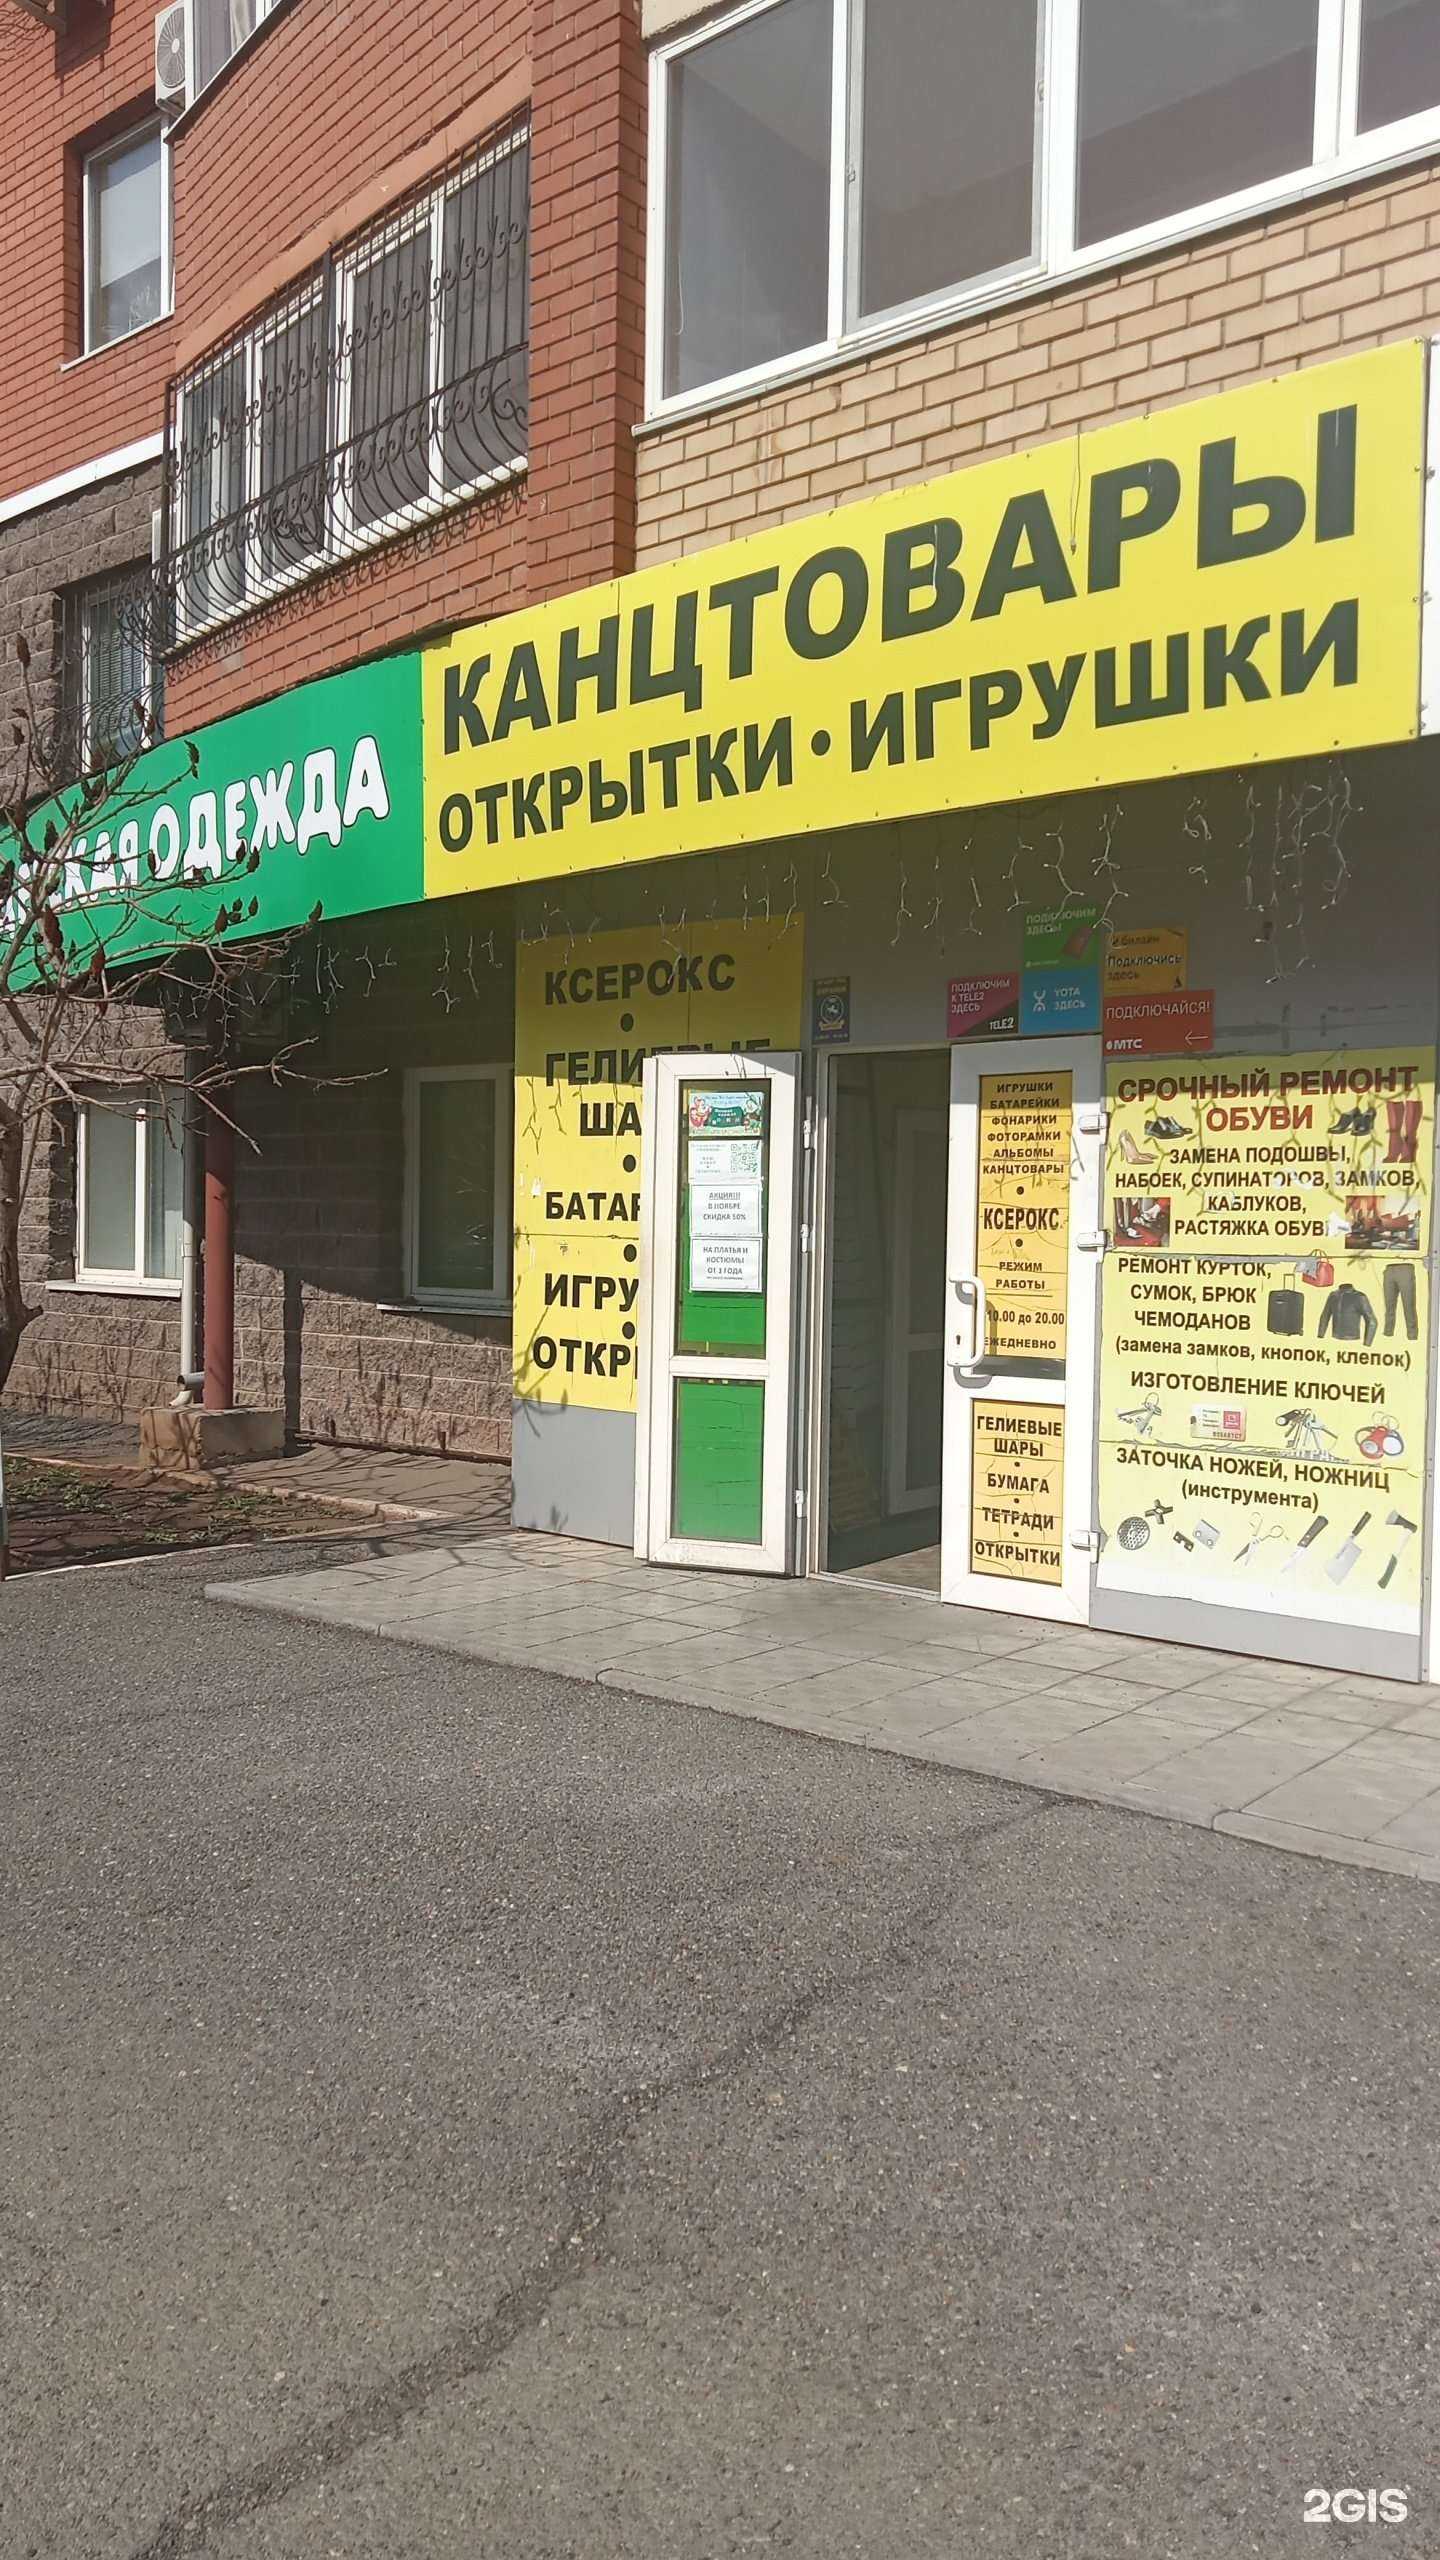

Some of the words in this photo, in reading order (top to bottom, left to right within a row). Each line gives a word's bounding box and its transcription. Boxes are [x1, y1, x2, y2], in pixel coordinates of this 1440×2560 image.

[441, 403, 1359, 755] КАНЦТОВАРЫ
[437, 714, 793, 853] ОТКРЫТКИ
[849, 598, 1359, 773] ИГРУШКИ
[149, 735, 391, 881] ОДЕЖДА
[544, 954, 736, 1005] КСЕРОКС
[952, 979, 1010, 992] ПОДКЛЮЧИМ
[960, 992, 984, 1002] TELE2
[1054, 987, 1080, 996] YOTA
[952, 1003, 980, 1014] ЗДЕСЬ
[1055, 1000, 1085, 1010] ЗДЕСЬ
[1106, 1000, 1209, 1019] ПОДКЛЮЧАЙСЯ!
[990, 1017, 1014, 1030] TELE2
[1114, 1039, 1142, 1049] МТС
[997, 1082, 1053, 1093] ИГРУШКИ
[1118, 1068, 1270, 1103] СРОЧНЫЙ
[1279, 1066, 1419, 1096] РЕМОНТ
[990, 1097, 1060, 1109] БАТАРЕЙКИ
[992, 1115, 1057, 1126] ФОНАРИКИ
[1206, 1105, 1314, 1131] ОБУВИ
[987, 1131, 1061, 1142] ФОТОРАМКИ
[993, 1148, 1054, 1158] АЛЬБОМЫ
[1170, 1147, 1240, 1164] ЗАМЕНА
[1246, 1146, 1350, 1164] ПОДОШВЫ,
[983, 1164, 1064, 1175] КАНЦТОВАРЫ
[1115, 1172, 1187, 1190] НАБОЕК,
[1335, 1170, 1420, 1188] ЗАМКОВ,
[1208, 1195, 1307, 1213] КАБЛУКОВ,
[984, 1208, 1059, 1230] КСЕРОКС
[1175, 1220, 1269, 1236] РАСТЯЖКА
[999, 1261, 1042, 1272] РЕЖИМ
[1118, 1258, 1190, 1274] РЕМОНТ
[1197, 1260, 1272, 1279] КУРТОК,
[996, 1279, 1045, 1289] РАБОТЫ
[1130, 1284, 1197, 1303] СУМОК,
[1202, 1286, 1257, 1303] БРЮК
[988, 1310, 1015, 1322] 10.00
[1018, 1314, 1031, 1325] до
[1035, 1312, 1064, 1324] 20.00
[1134, 1310, 1251, 1331] ЧЕМОДАНОВ
[984, 1337, 1056, 1349] ЕЖЕДНЕВНО
[533, 1336, 638, 1379] ОТКР
[1116, 1336, 1182, 1354] (замена
[1187, 1342, 1256, 1361] замков,
[1261, 1346, 1331, 1364] кнопок,
[1336, 1350, 1411, 1371] клепок)
[1131, 1371, 1287, 1397] ИЗГОТОВЛЕНИЕ
[1294, 1381, 1385, 1404] КЛЮЧЕЙ
[977, 1415, 1062, 1436] ГЕЛИЕВЫЕ
[994, 1438, 1043, 1457] ШАРЫ
[1117, 1448, 1203, 1471] ЗАТОЧКА
[1210, 1456, 1288, 1482] НОЖЕЙ,
[1295, 1464, 1391, 1492] НОЖНИЦ
[987, 1473, 1050, 1493] БУМАГА
[1182, 1479, 1319, 1513] (инструмента)
[982, 1506, 1054, 1530] ТЕТРАДИ
[975, 1542, 1060, 1566] ОТКРЫТКИ
